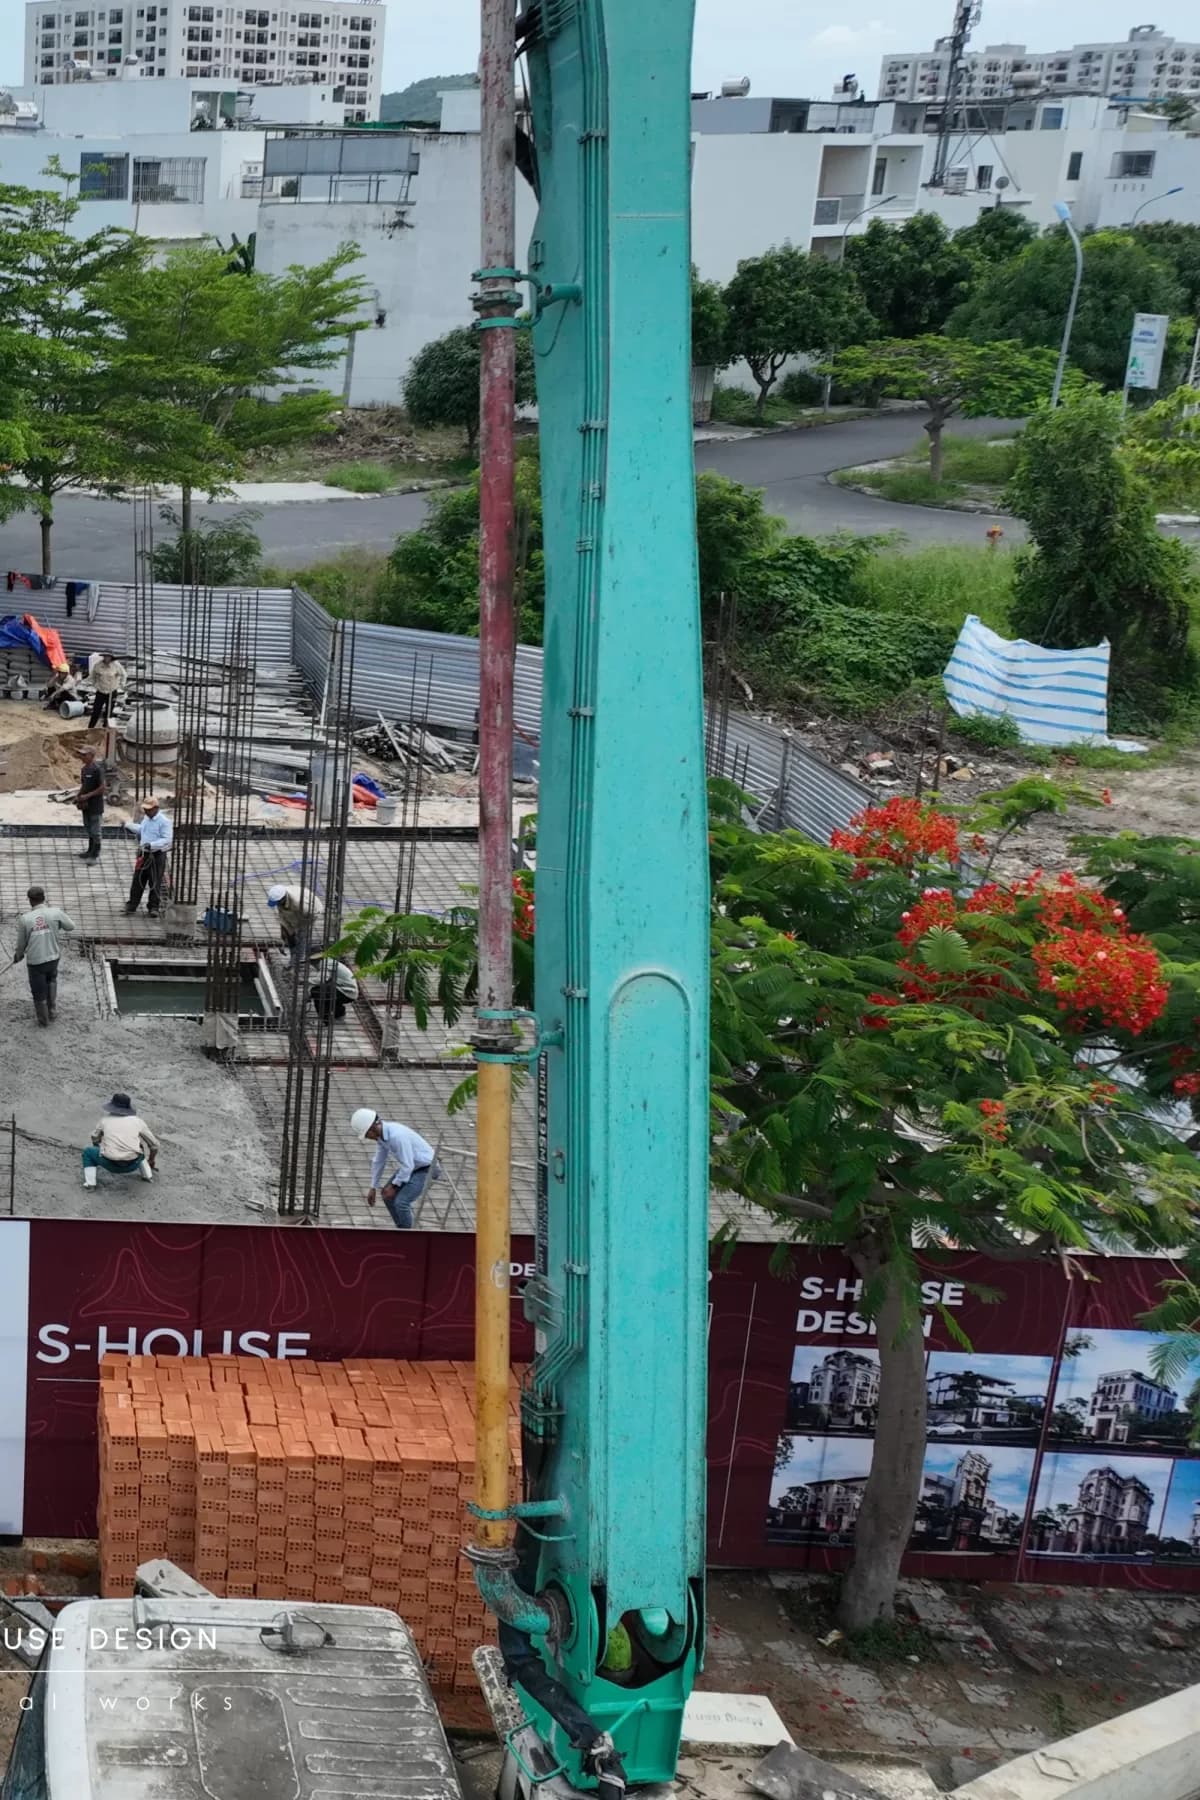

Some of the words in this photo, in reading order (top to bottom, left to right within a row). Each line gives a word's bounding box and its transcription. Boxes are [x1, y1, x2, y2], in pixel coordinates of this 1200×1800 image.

[800, 1276, 966, 1306] S-HSE
[796, 1309, 933, 1338] DESIN
[35, 1323, 312, 1365] S-HOUSE
